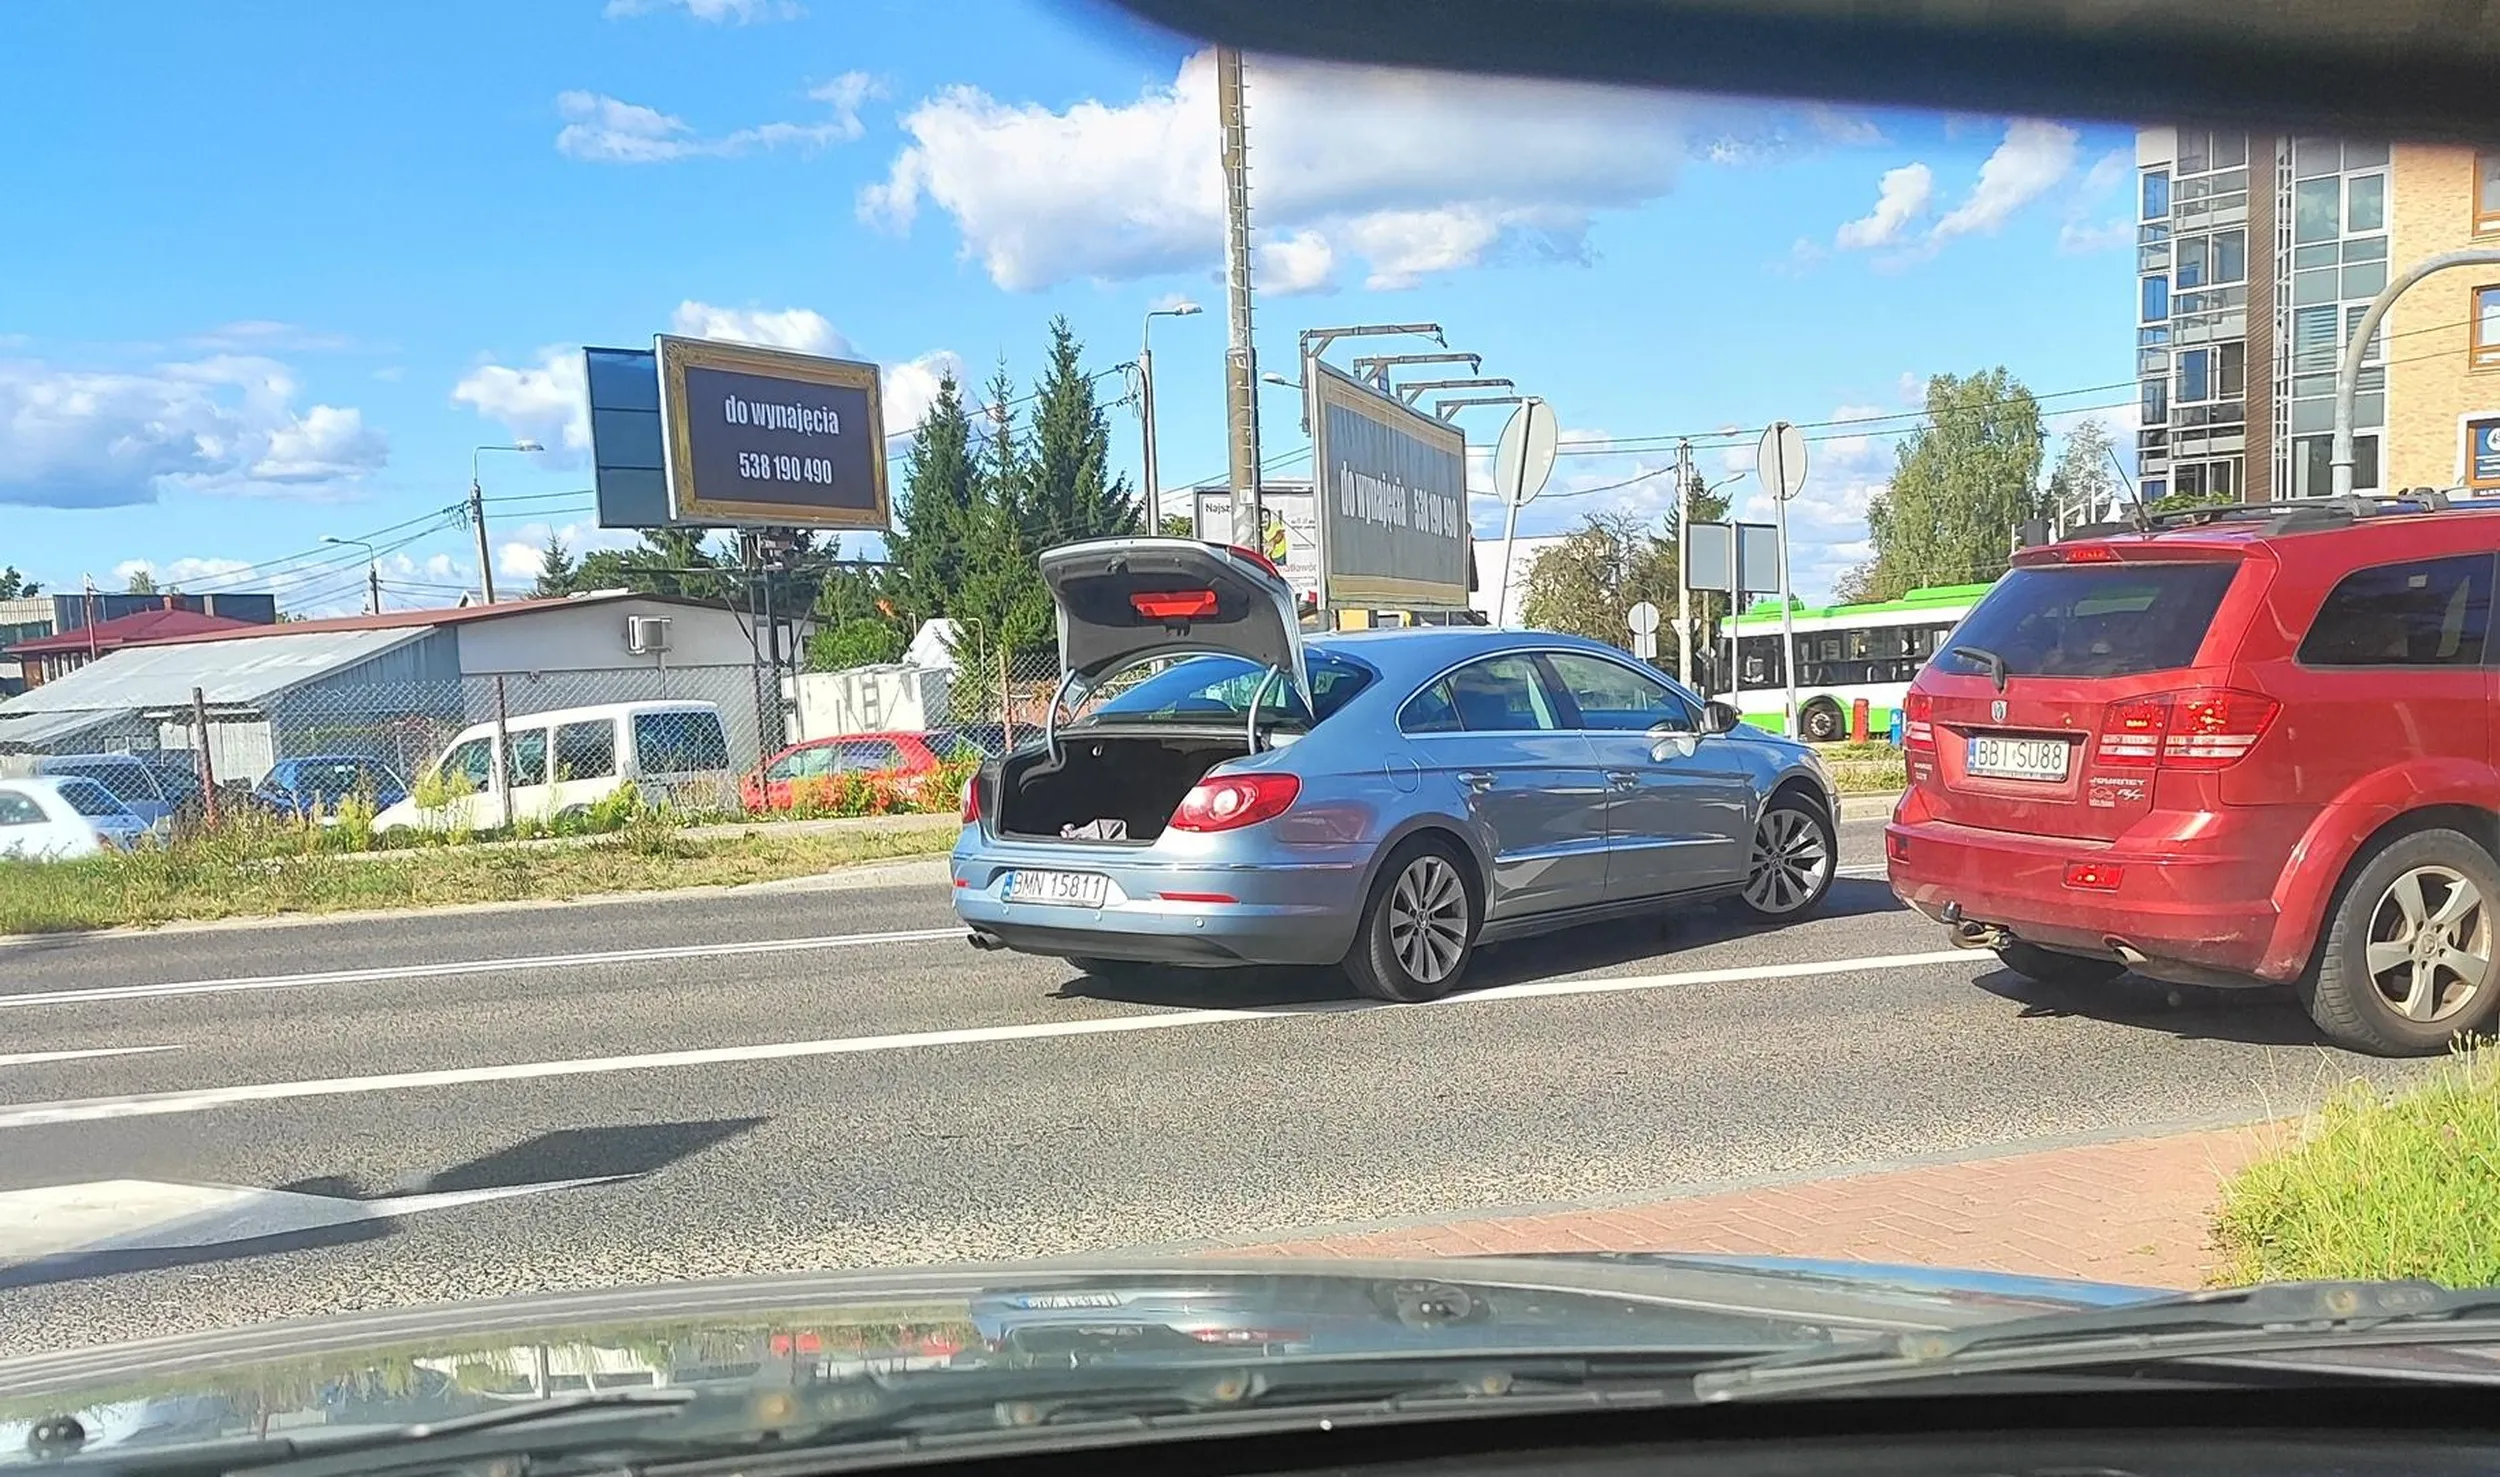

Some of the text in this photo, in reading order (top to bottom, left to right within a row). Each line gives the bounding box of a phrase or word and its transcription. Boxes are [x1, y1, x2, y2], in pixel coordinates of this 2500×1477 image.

[725, 395, 840, 437] do wynajęcia
[739, 452, 832, 485] 538 190 490
[1340, 460, 1355, 517] do
[1355, 471, 1407, 533] wynajęcia
[1978, 740, 2062, 770] BBI SU88
[2089, 777, 2145, 786] JOURNEY
[1012, 872, 1101, 899] BMN 15811
